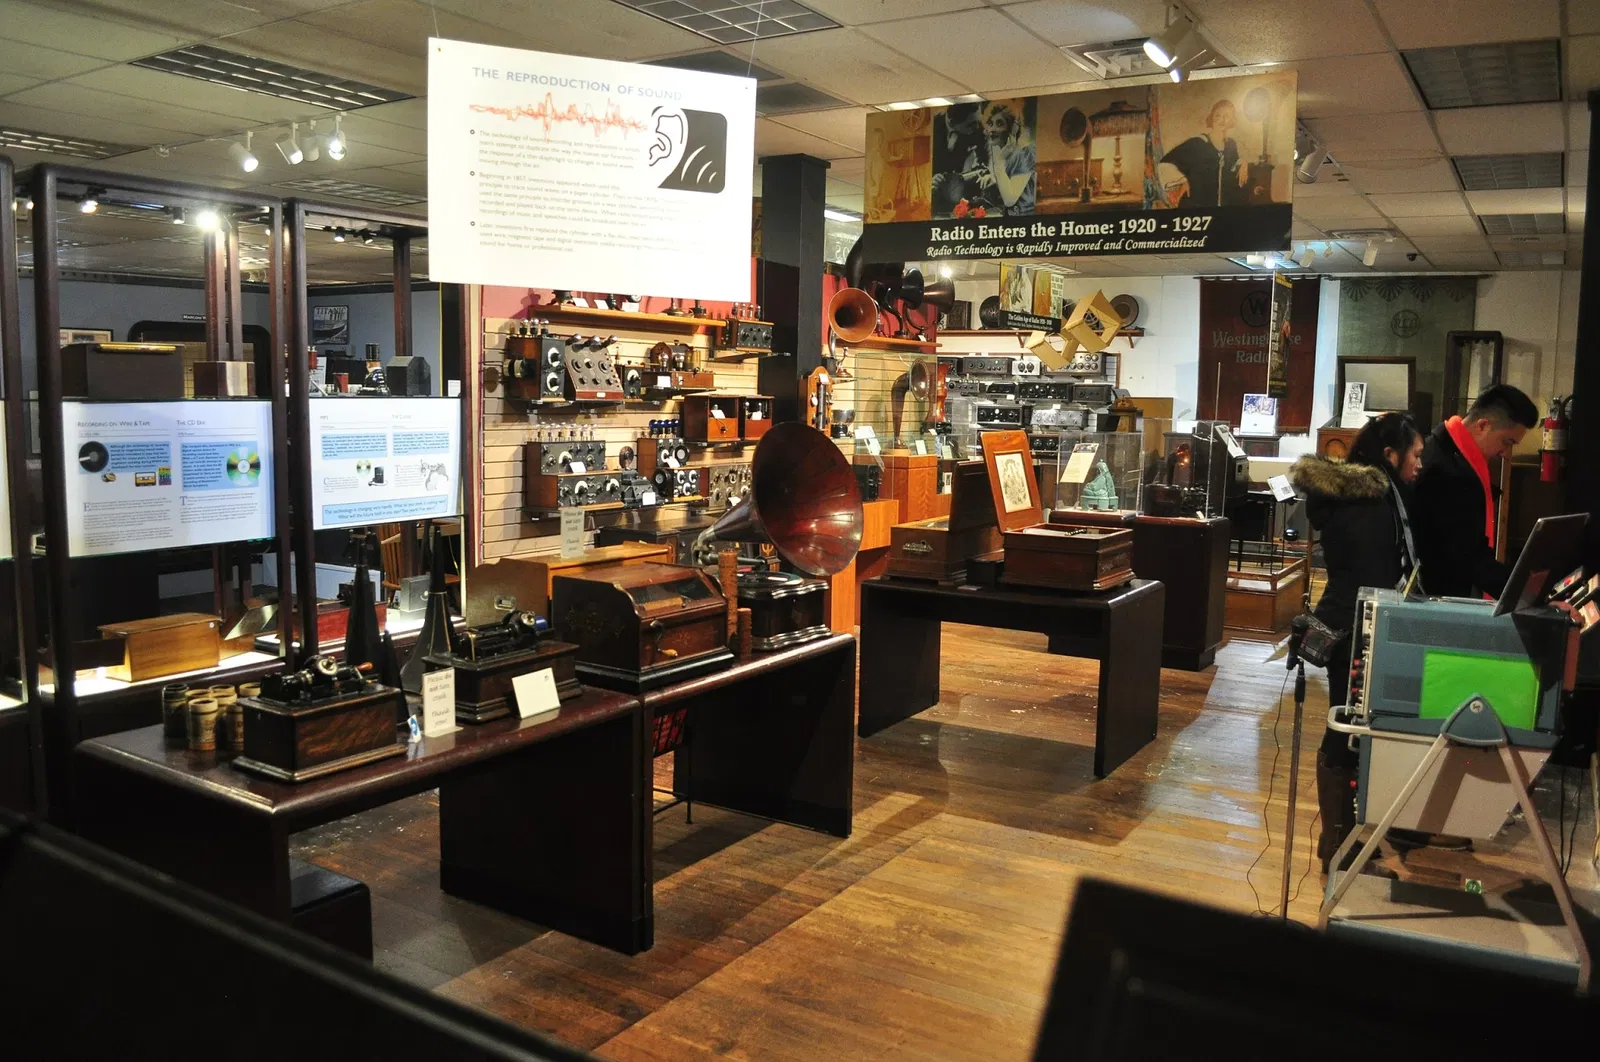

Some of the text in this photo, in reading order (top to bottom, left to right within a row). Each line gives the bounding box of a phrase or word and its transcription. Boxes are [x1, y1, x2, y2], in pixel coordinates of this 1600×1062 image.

[471, 66, 681, 100] THE REPRODUCTION OF SOUND
[931, 226, 974, 241] Radio
[978, 224, 1026, 239] Enters
[1031, 222, 1056, 237] the
[1060, 220, 1114, 236] Home:
[1118, 218, 1156, 234] 1920
[1172, 216, 1212, 232] 1927
[926, 235, 1208, 257] Radio Technology is Rapidly Improved and Commercialized
[1212, 330, 1302, 348] Westingse
[432, 708, 450, 717] Thank
